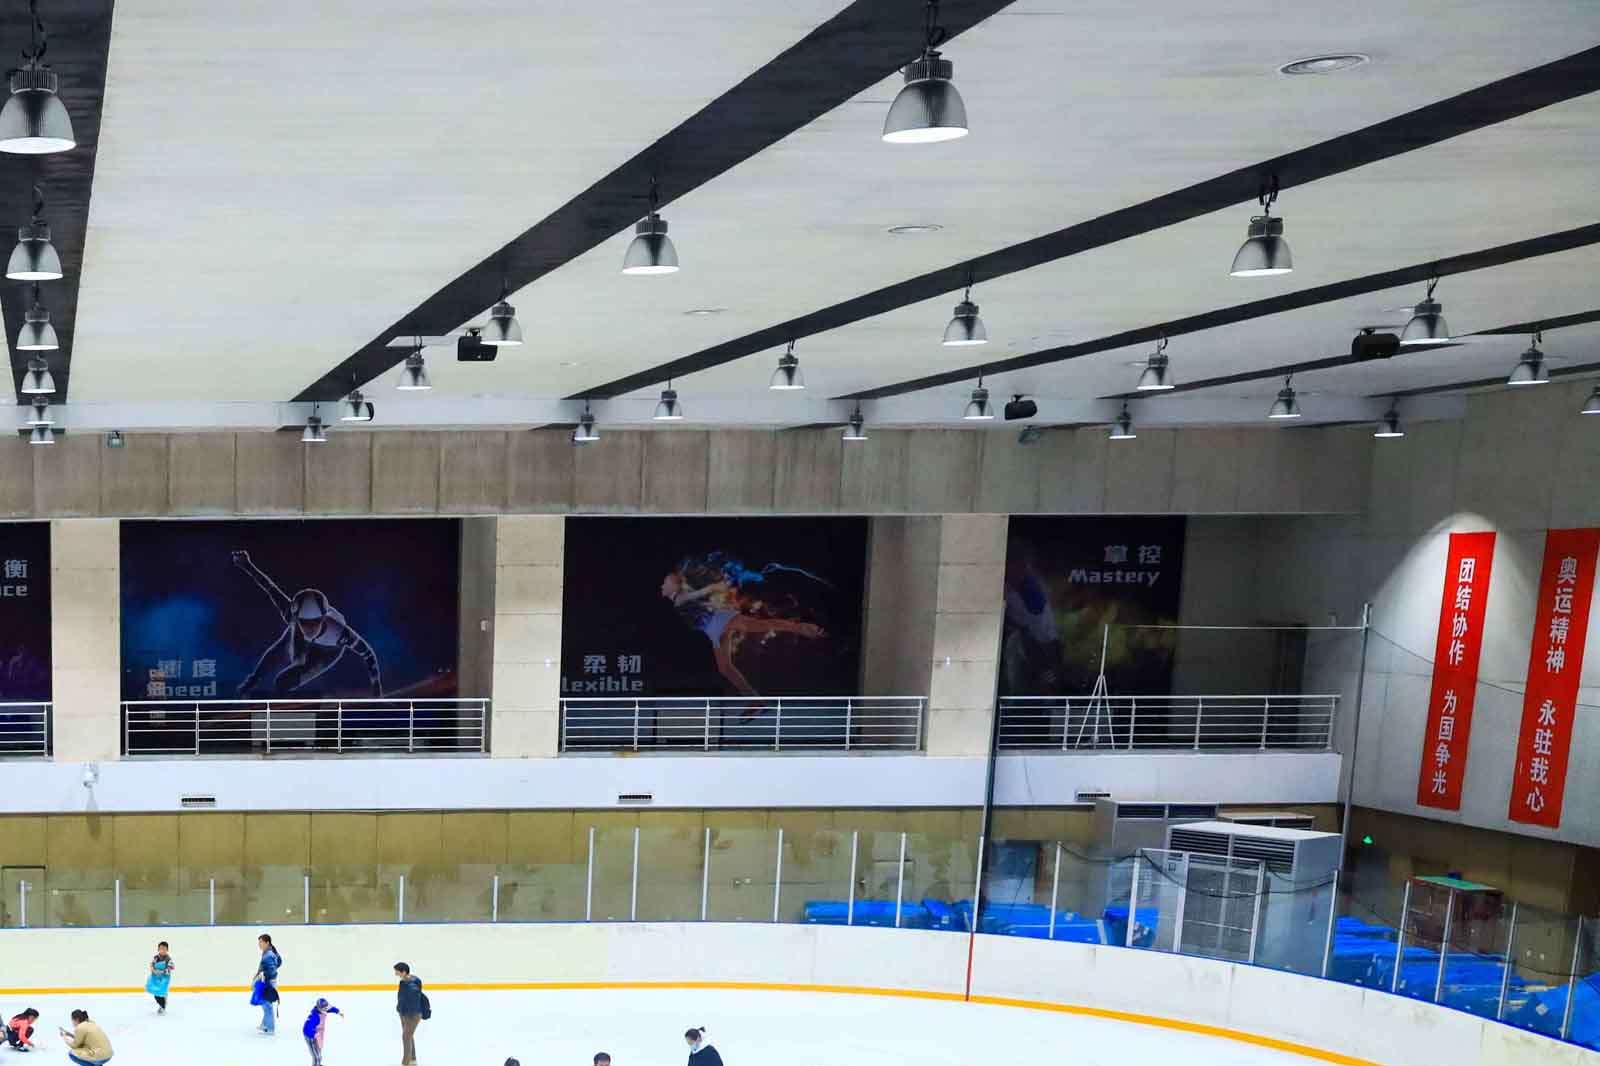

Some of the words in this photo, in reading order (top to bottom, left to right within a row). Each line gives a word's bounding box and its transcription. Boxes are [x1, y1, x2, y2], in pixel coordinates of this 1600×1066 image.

[1068, 568, 1161, 587] Mastery
[1448, 557, 1476, 666] 团结协作
[1545, 556, 1578, 675] 奥运精神
[583, 654, 642, 674] 柔韧
[1431, 689, 1458, 795] 为国争光
[1525, 699, 1558, 813] 永驻我心
